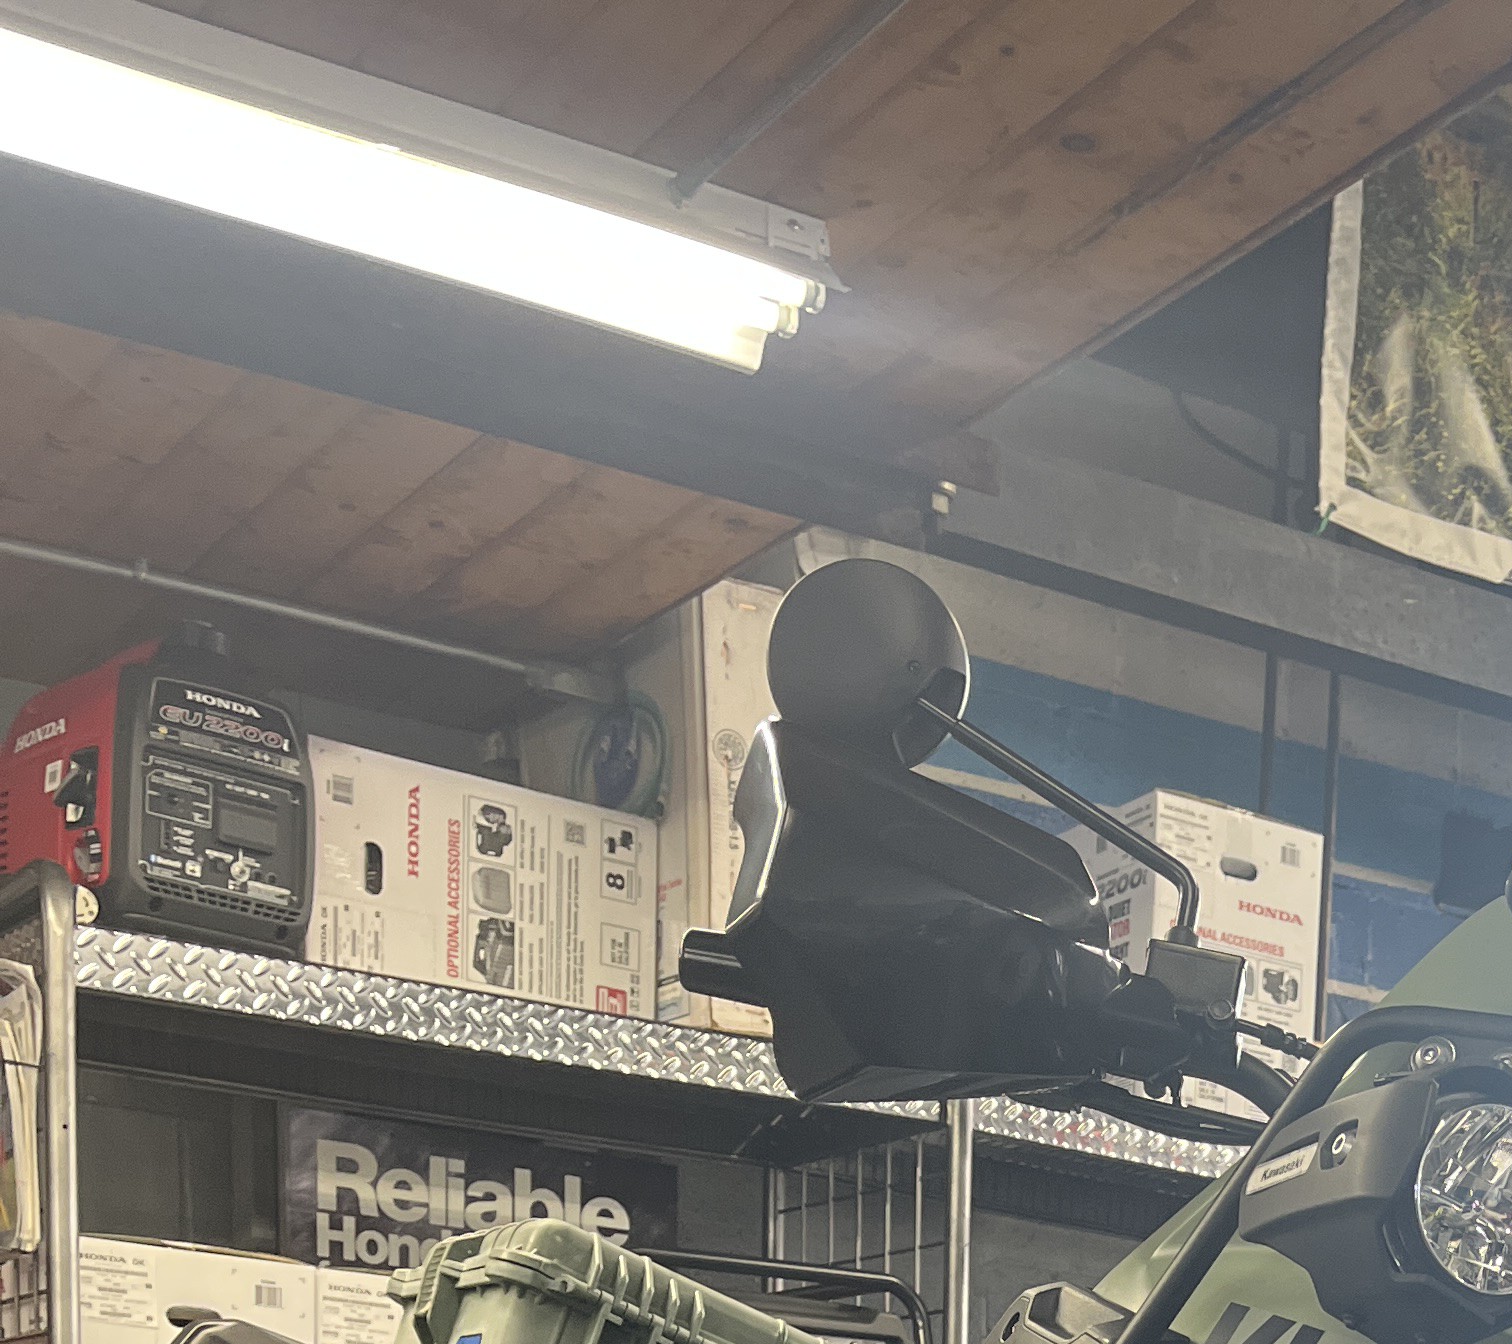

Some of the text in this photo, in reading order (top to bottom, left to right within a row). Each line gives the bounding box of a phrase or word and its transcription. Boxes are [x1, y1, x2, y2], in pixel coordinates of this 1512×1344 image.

[184, 689, 262, 719] HONDA
[14, 717, 66, 754] HONDA
[407, 785, 421, 878] HONDA
[606, 872, 626, 891] 8
[446, 818, 461, 979] OPTIONAL ACCESSORIES
[1238, 900, 1303, 926] HONDA
[1220, 932, 1285, 957] ACCESSORIES
[1260, 1154, 1305, 1182] Kawasaki
[316, 1138, 631, 1247] Reliable
[328, 1283, 372, 1297] HONDA
